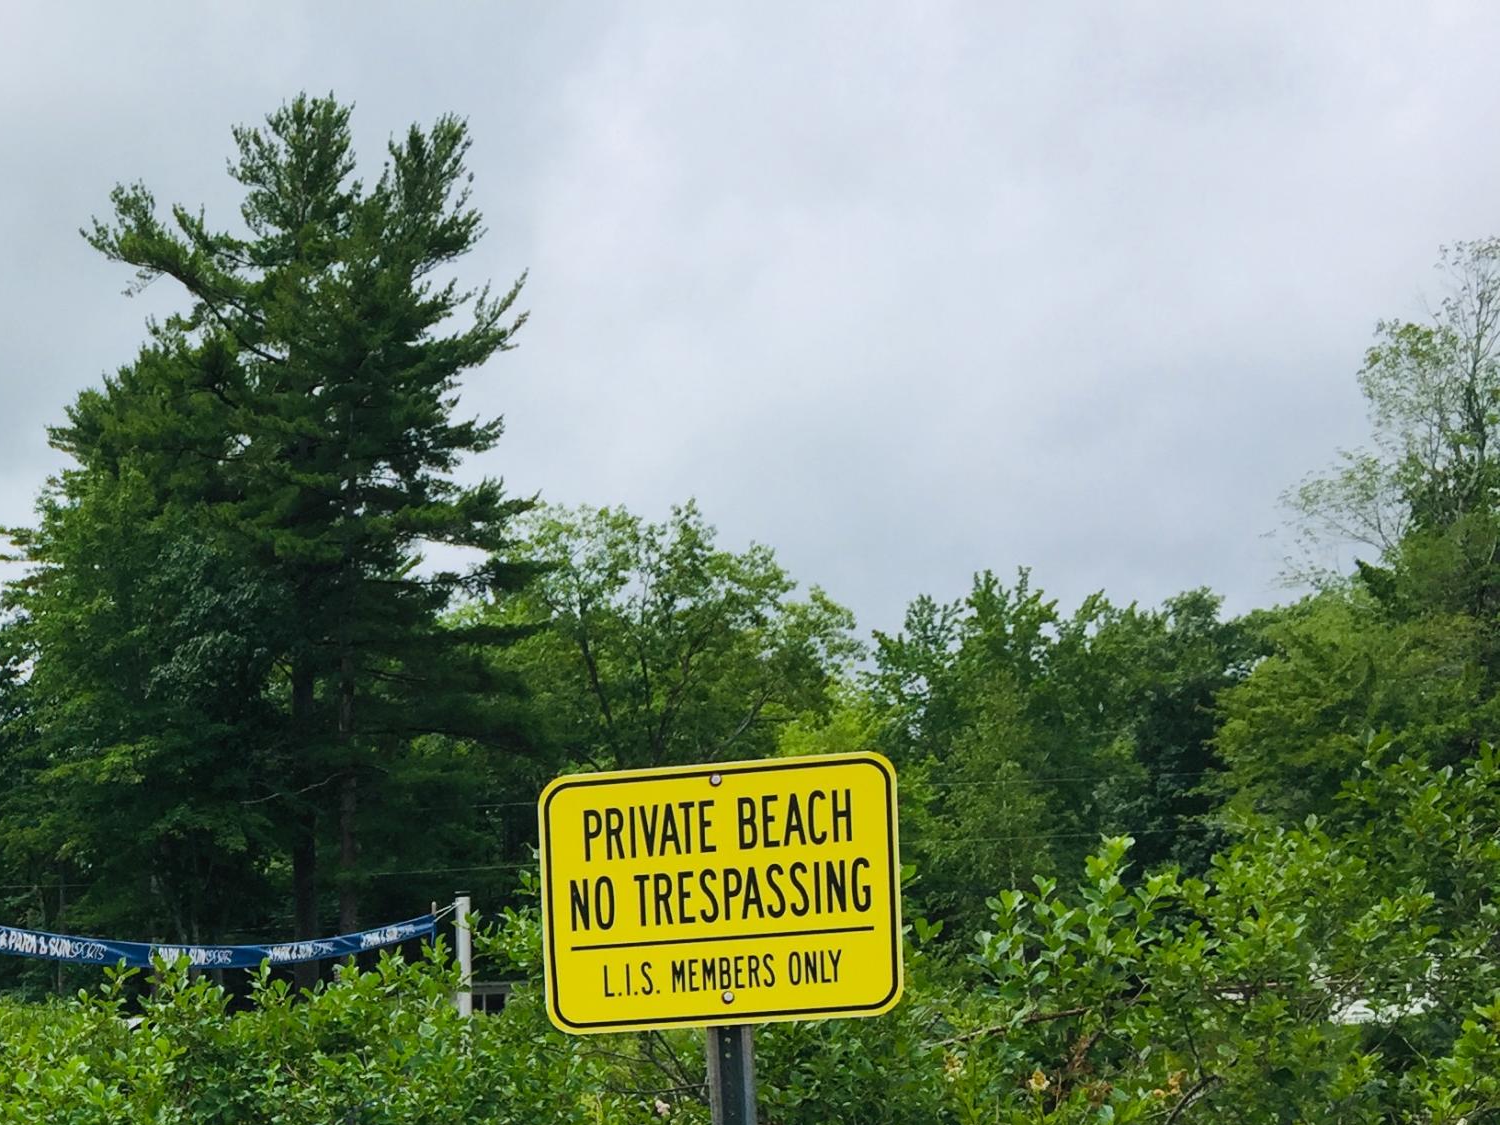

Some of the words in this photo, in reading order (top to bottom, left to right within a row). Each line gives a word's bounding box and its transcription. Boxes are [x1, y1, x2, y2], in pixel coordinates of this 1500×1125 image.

[583, 800, 717, 862] PRIVATE
[737, 788, 853, 850] BEACH
[569, 875, 615, 932] NO
[633, 857, 872, 927] TRESPASSING
[603, 961, 661, 998] L.I.S.
[671, 953, 776, 993] MEMBERS
[788, 949, 842, 986] ONLY
